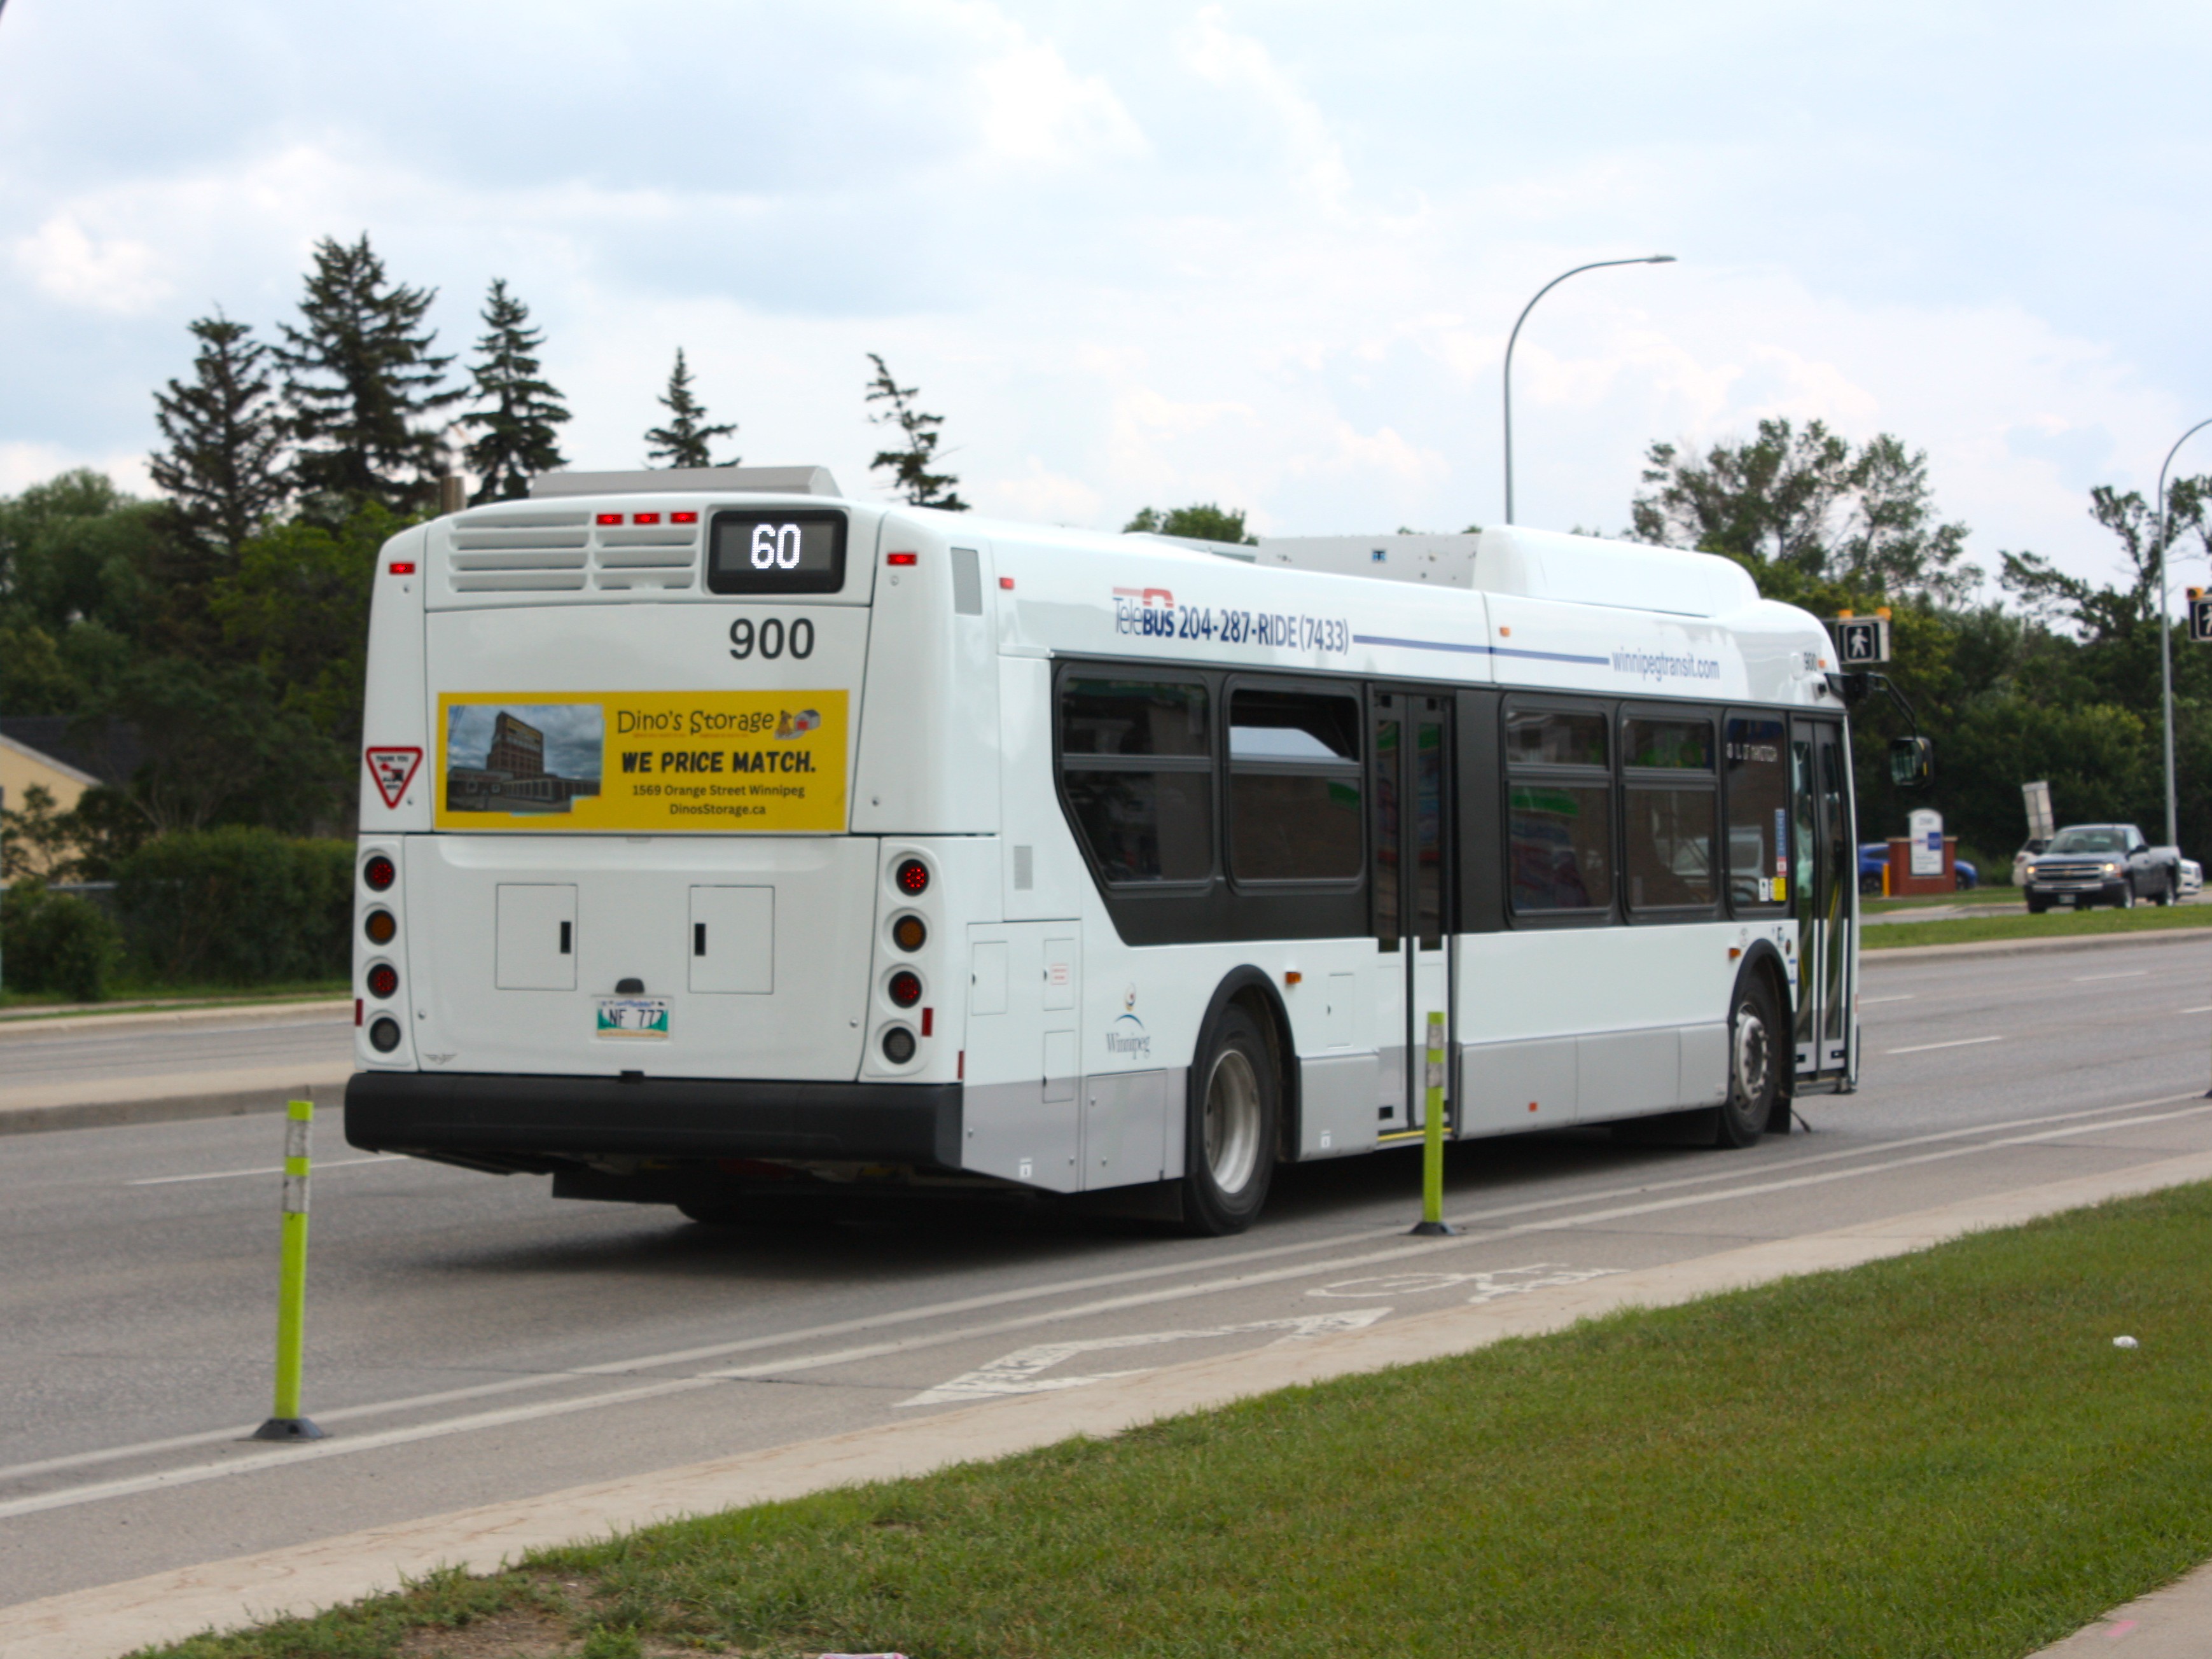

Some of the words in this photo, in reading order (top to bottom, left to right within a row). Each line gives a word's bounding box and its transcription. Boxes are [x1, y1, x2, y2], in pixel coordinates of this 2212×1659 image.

[751, 524, 802, 569] 60
[730, 617, 814, 660] 900
[1112, 597, 1175, 638] TeleBUS
[1300, 614, 1350, 656] (7433)
[1611, 646, 1720, 682] winnipegtransit.com
[617, 710, 683, 733] Dino's
[690, 709, 774, 735] Storage
[622, 751, 653, 774] WE
[661, 751, 725, 774] PRICE
[732, 751, 817, 774] MATCH.
[633, 785, 661, 796] 1569
[664, 784, 707, 798] Orange
[709, 784, 746, 796] Street
[749, 784, 805, 799] Winnipeg
[670, 803, 767, 817] DinosStorage.ca
[1106, 1032, 1151, 1060] Winnipeg
